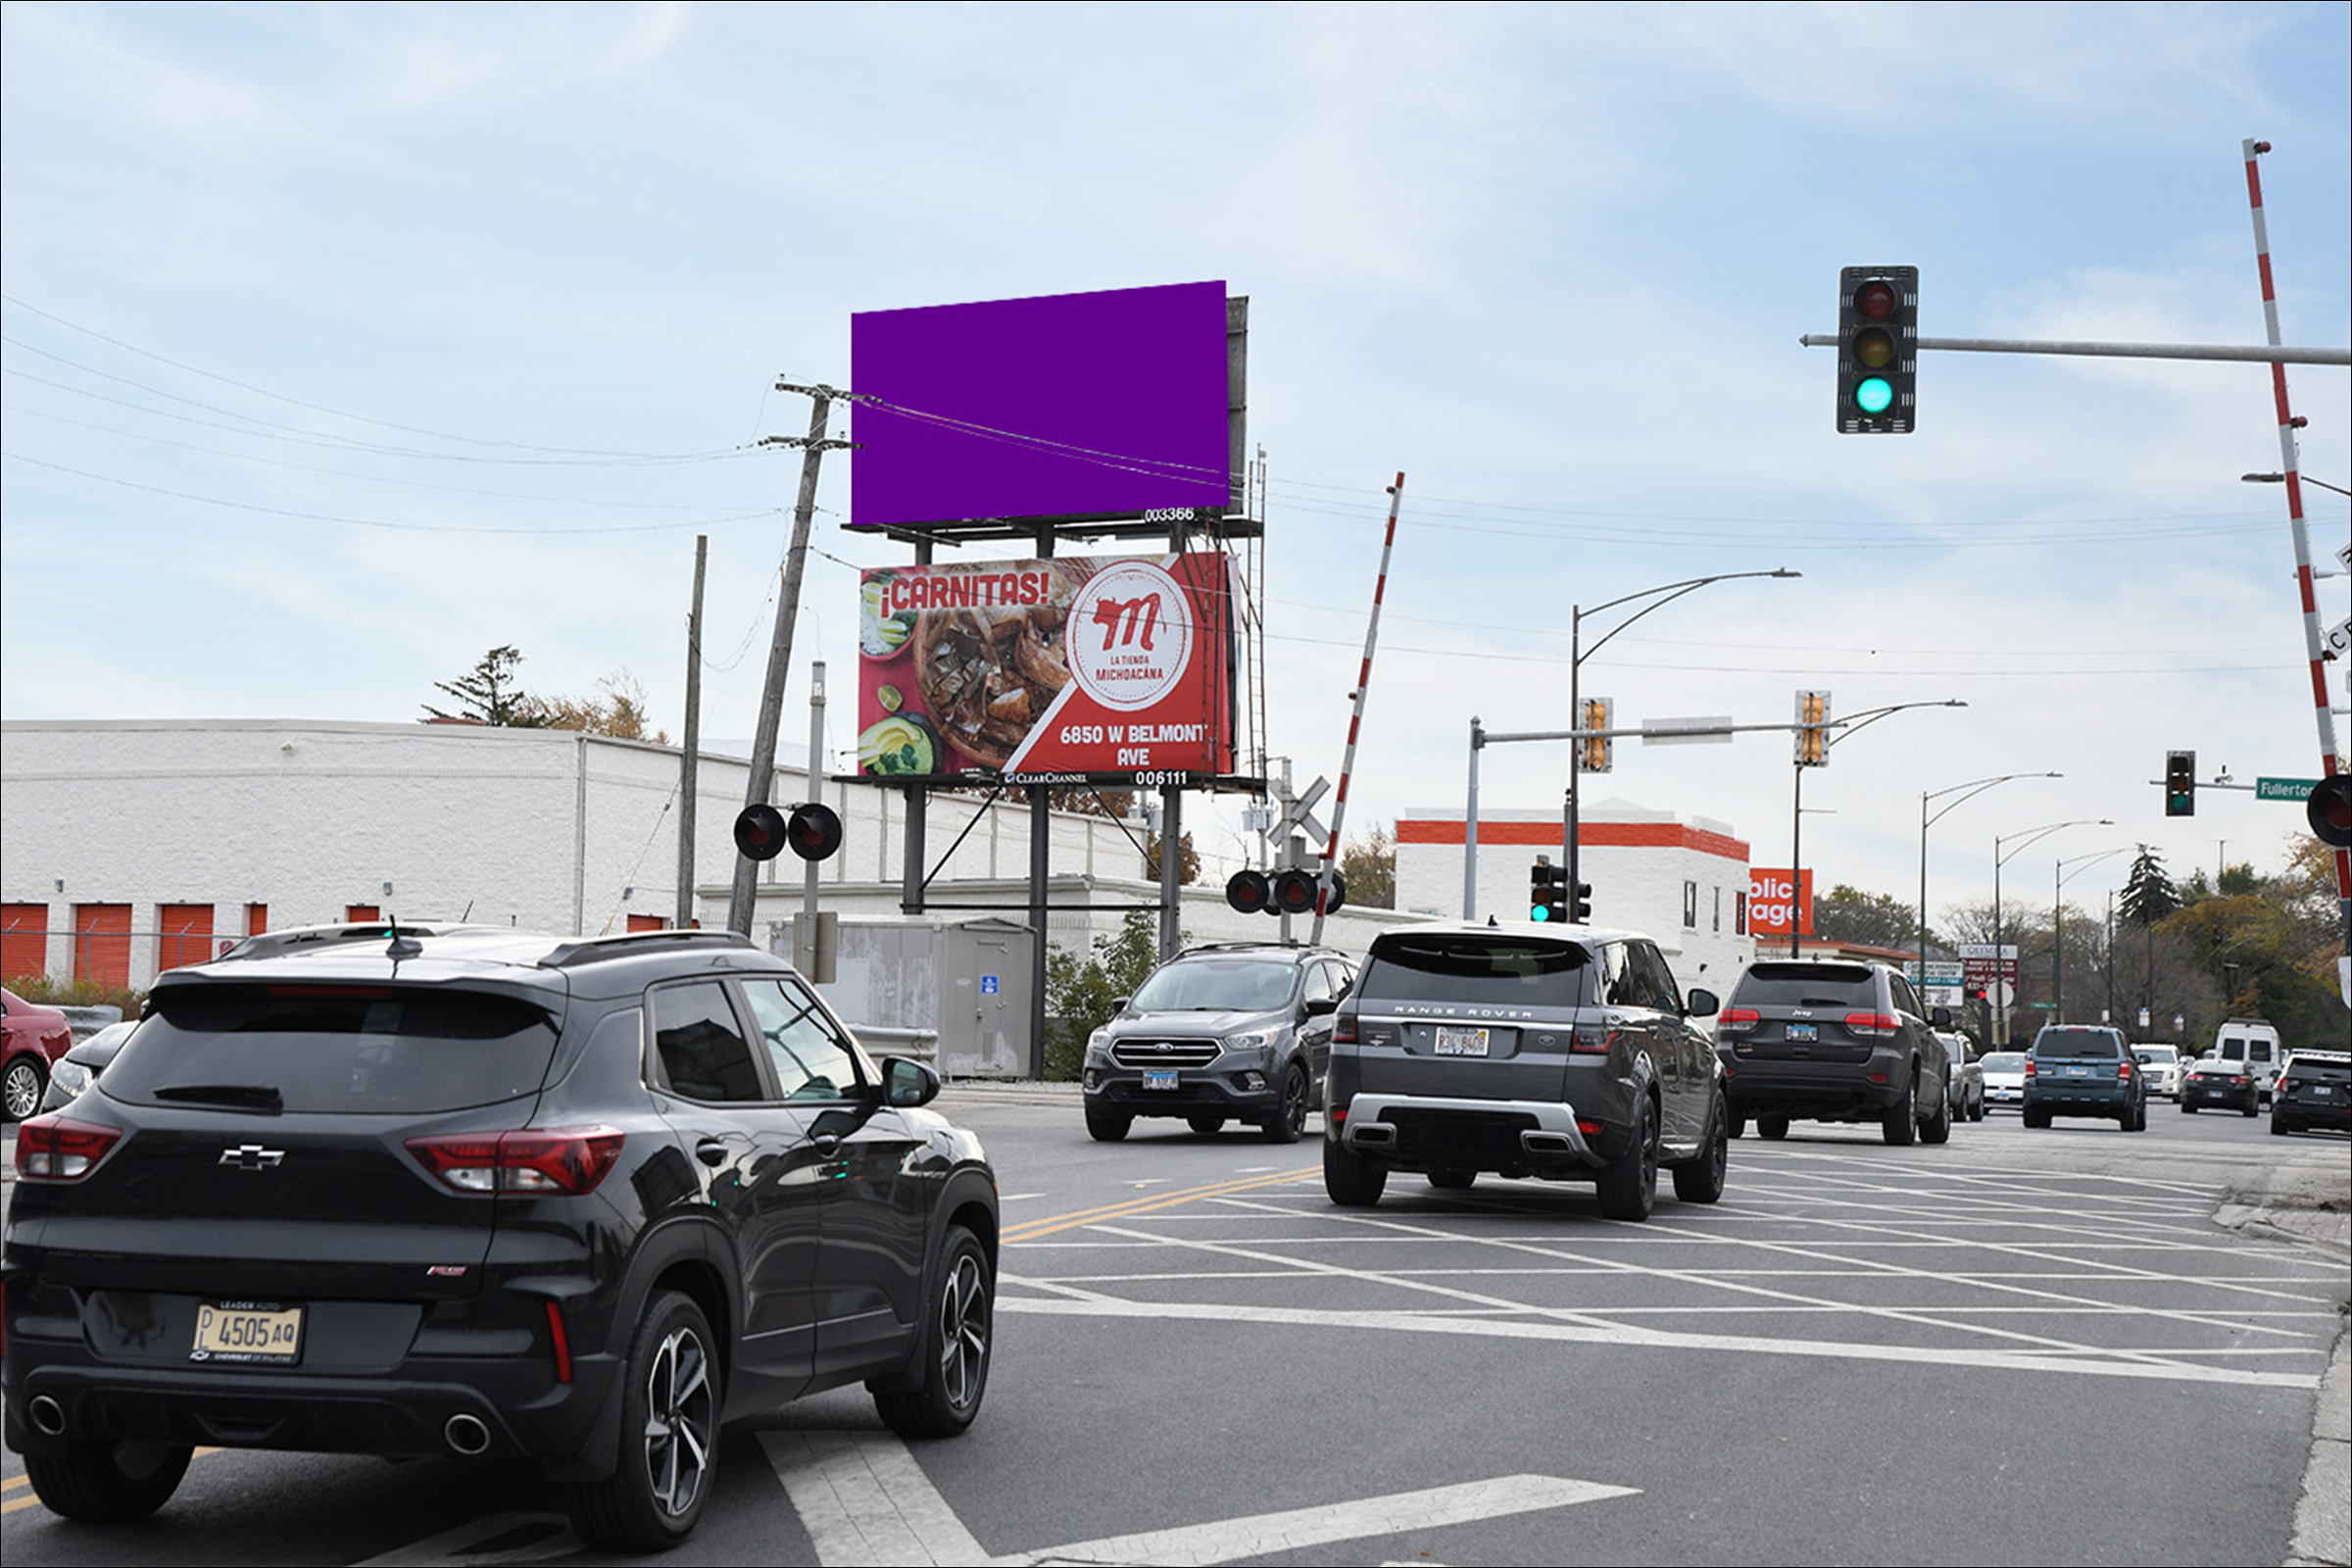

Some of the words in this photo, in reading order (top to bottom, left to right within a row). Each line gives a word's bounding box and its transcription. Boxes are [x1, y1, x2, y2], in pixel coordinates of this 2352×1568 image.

[1145, 507, 1195, 522] 003366
[881, 571, 1050, 618] ¡CARNITAS!
[1109, 656, 1120, 665] LA
[1122, 655, 1150, 665] TIENDA
[1060, 725, 1102, 745] 6850
[1107, 725, 1124, 744] W
[1128, 723, 1208, 743] BELMONT
[1117, 748, 1150, 766] AVE
[1135, 770, 1187, 785] 006111
[1749, 904, 1802, 926] age
[1395, 1005, 1455, 1015] RANGE
[1468, 1008, 1532, 1018] ROVER
[1791, 1008, 1813, 1018] Jeep
[220, 1300, 254, 1310] LEADER
